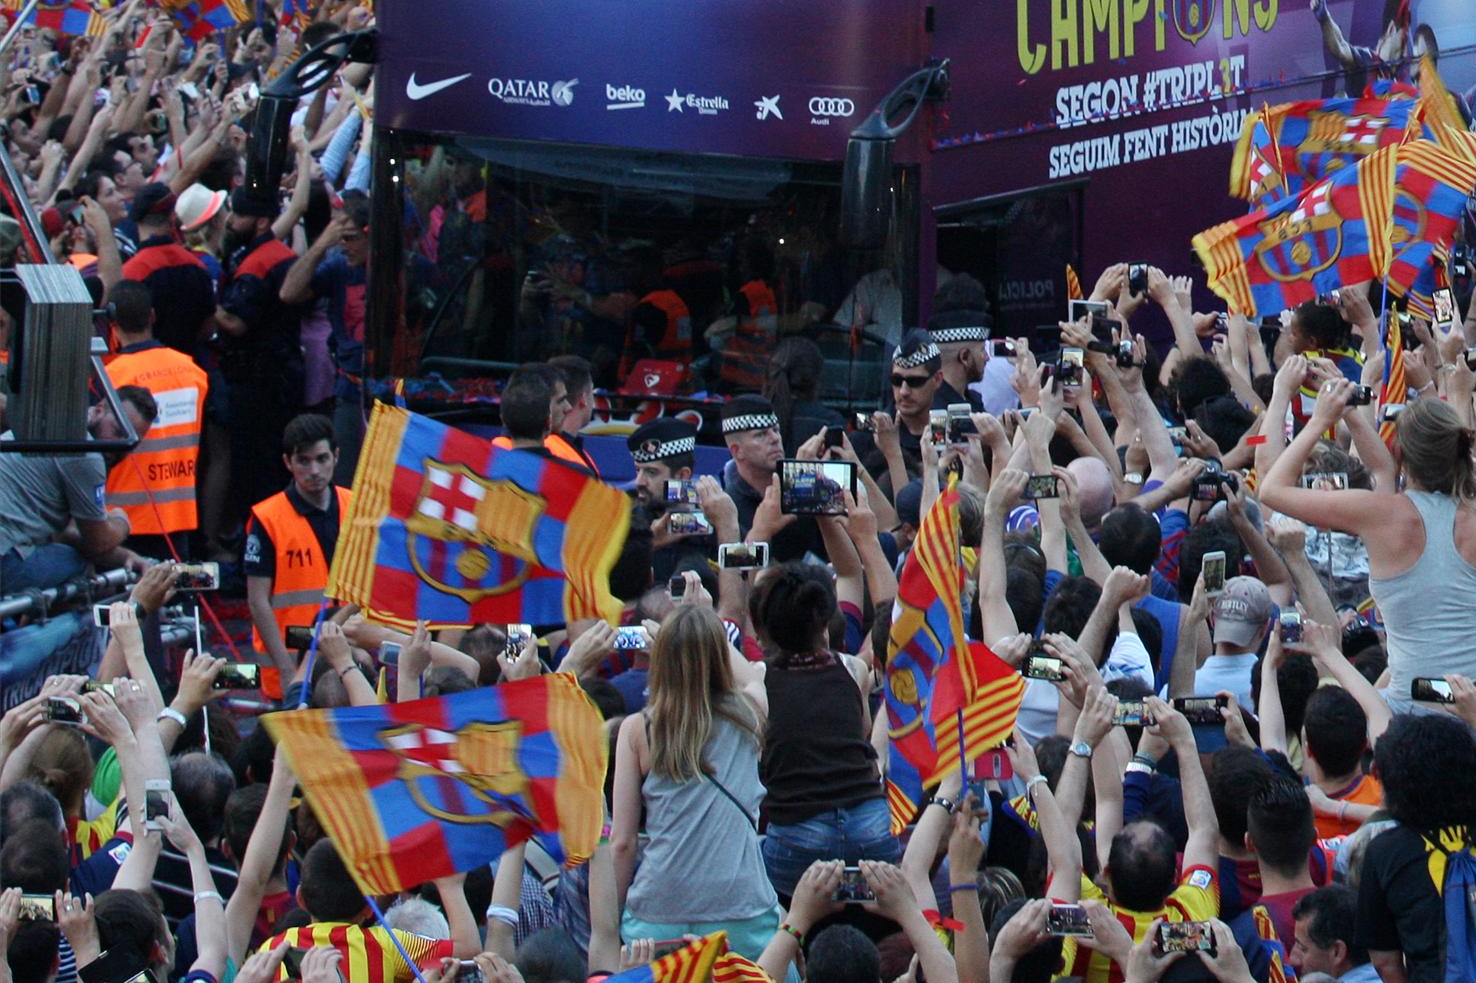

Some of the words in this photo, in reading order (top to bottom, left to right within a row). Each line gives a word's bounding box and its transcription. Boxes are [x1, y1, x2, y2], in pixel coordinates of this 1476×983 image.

[488, 77, 549, 98] QATAR
[606, 83, 646, 102] beko
[1056, 76, 1138, 129] SEGON
[1143, 55, 1246, 110] #TRIPL3T
[686, 93, 729, 111] Estrella
[810, 117, 830, 126] Audi
[1049, 135, 1120, 179] SEGUIM
[1123, 127, 1168, 164] FENT
[148, 460, 196, 481] STEWAR
[286, 548, 313, 569] 711
